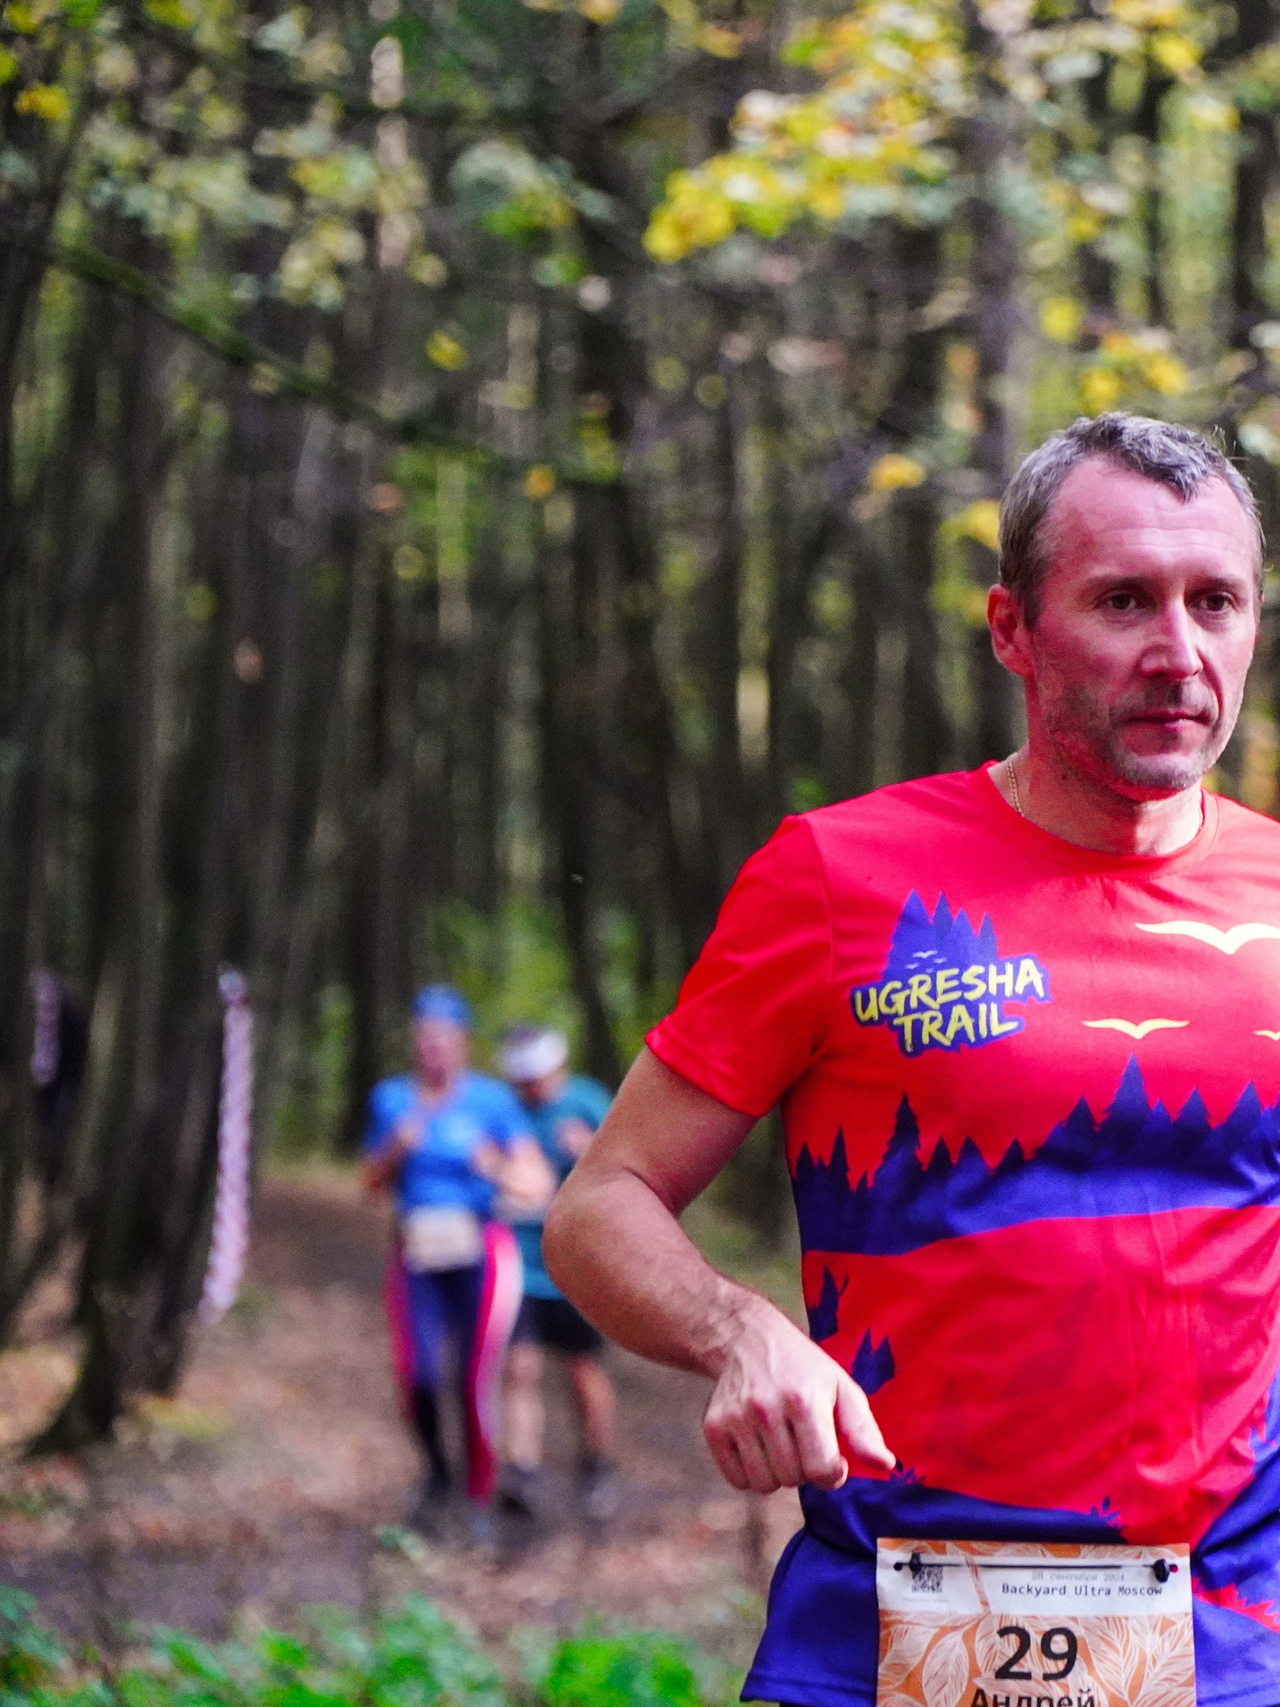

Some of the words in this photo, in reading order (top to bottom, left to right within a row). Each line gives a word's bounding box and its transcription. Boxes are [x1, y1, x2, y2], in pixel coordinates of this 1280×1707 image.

[854, 957, 1045, 1022] UGRESHA
[893, 1001, 1019, 1053] TRAIL
[1001, 1583, 1067, 1597] Backyard
[1074, 1584, 1111, 1596] Ultra
[1117, 1585, 1163, 1597] Moscow
[994, 1626, 1079, 1681] 29
